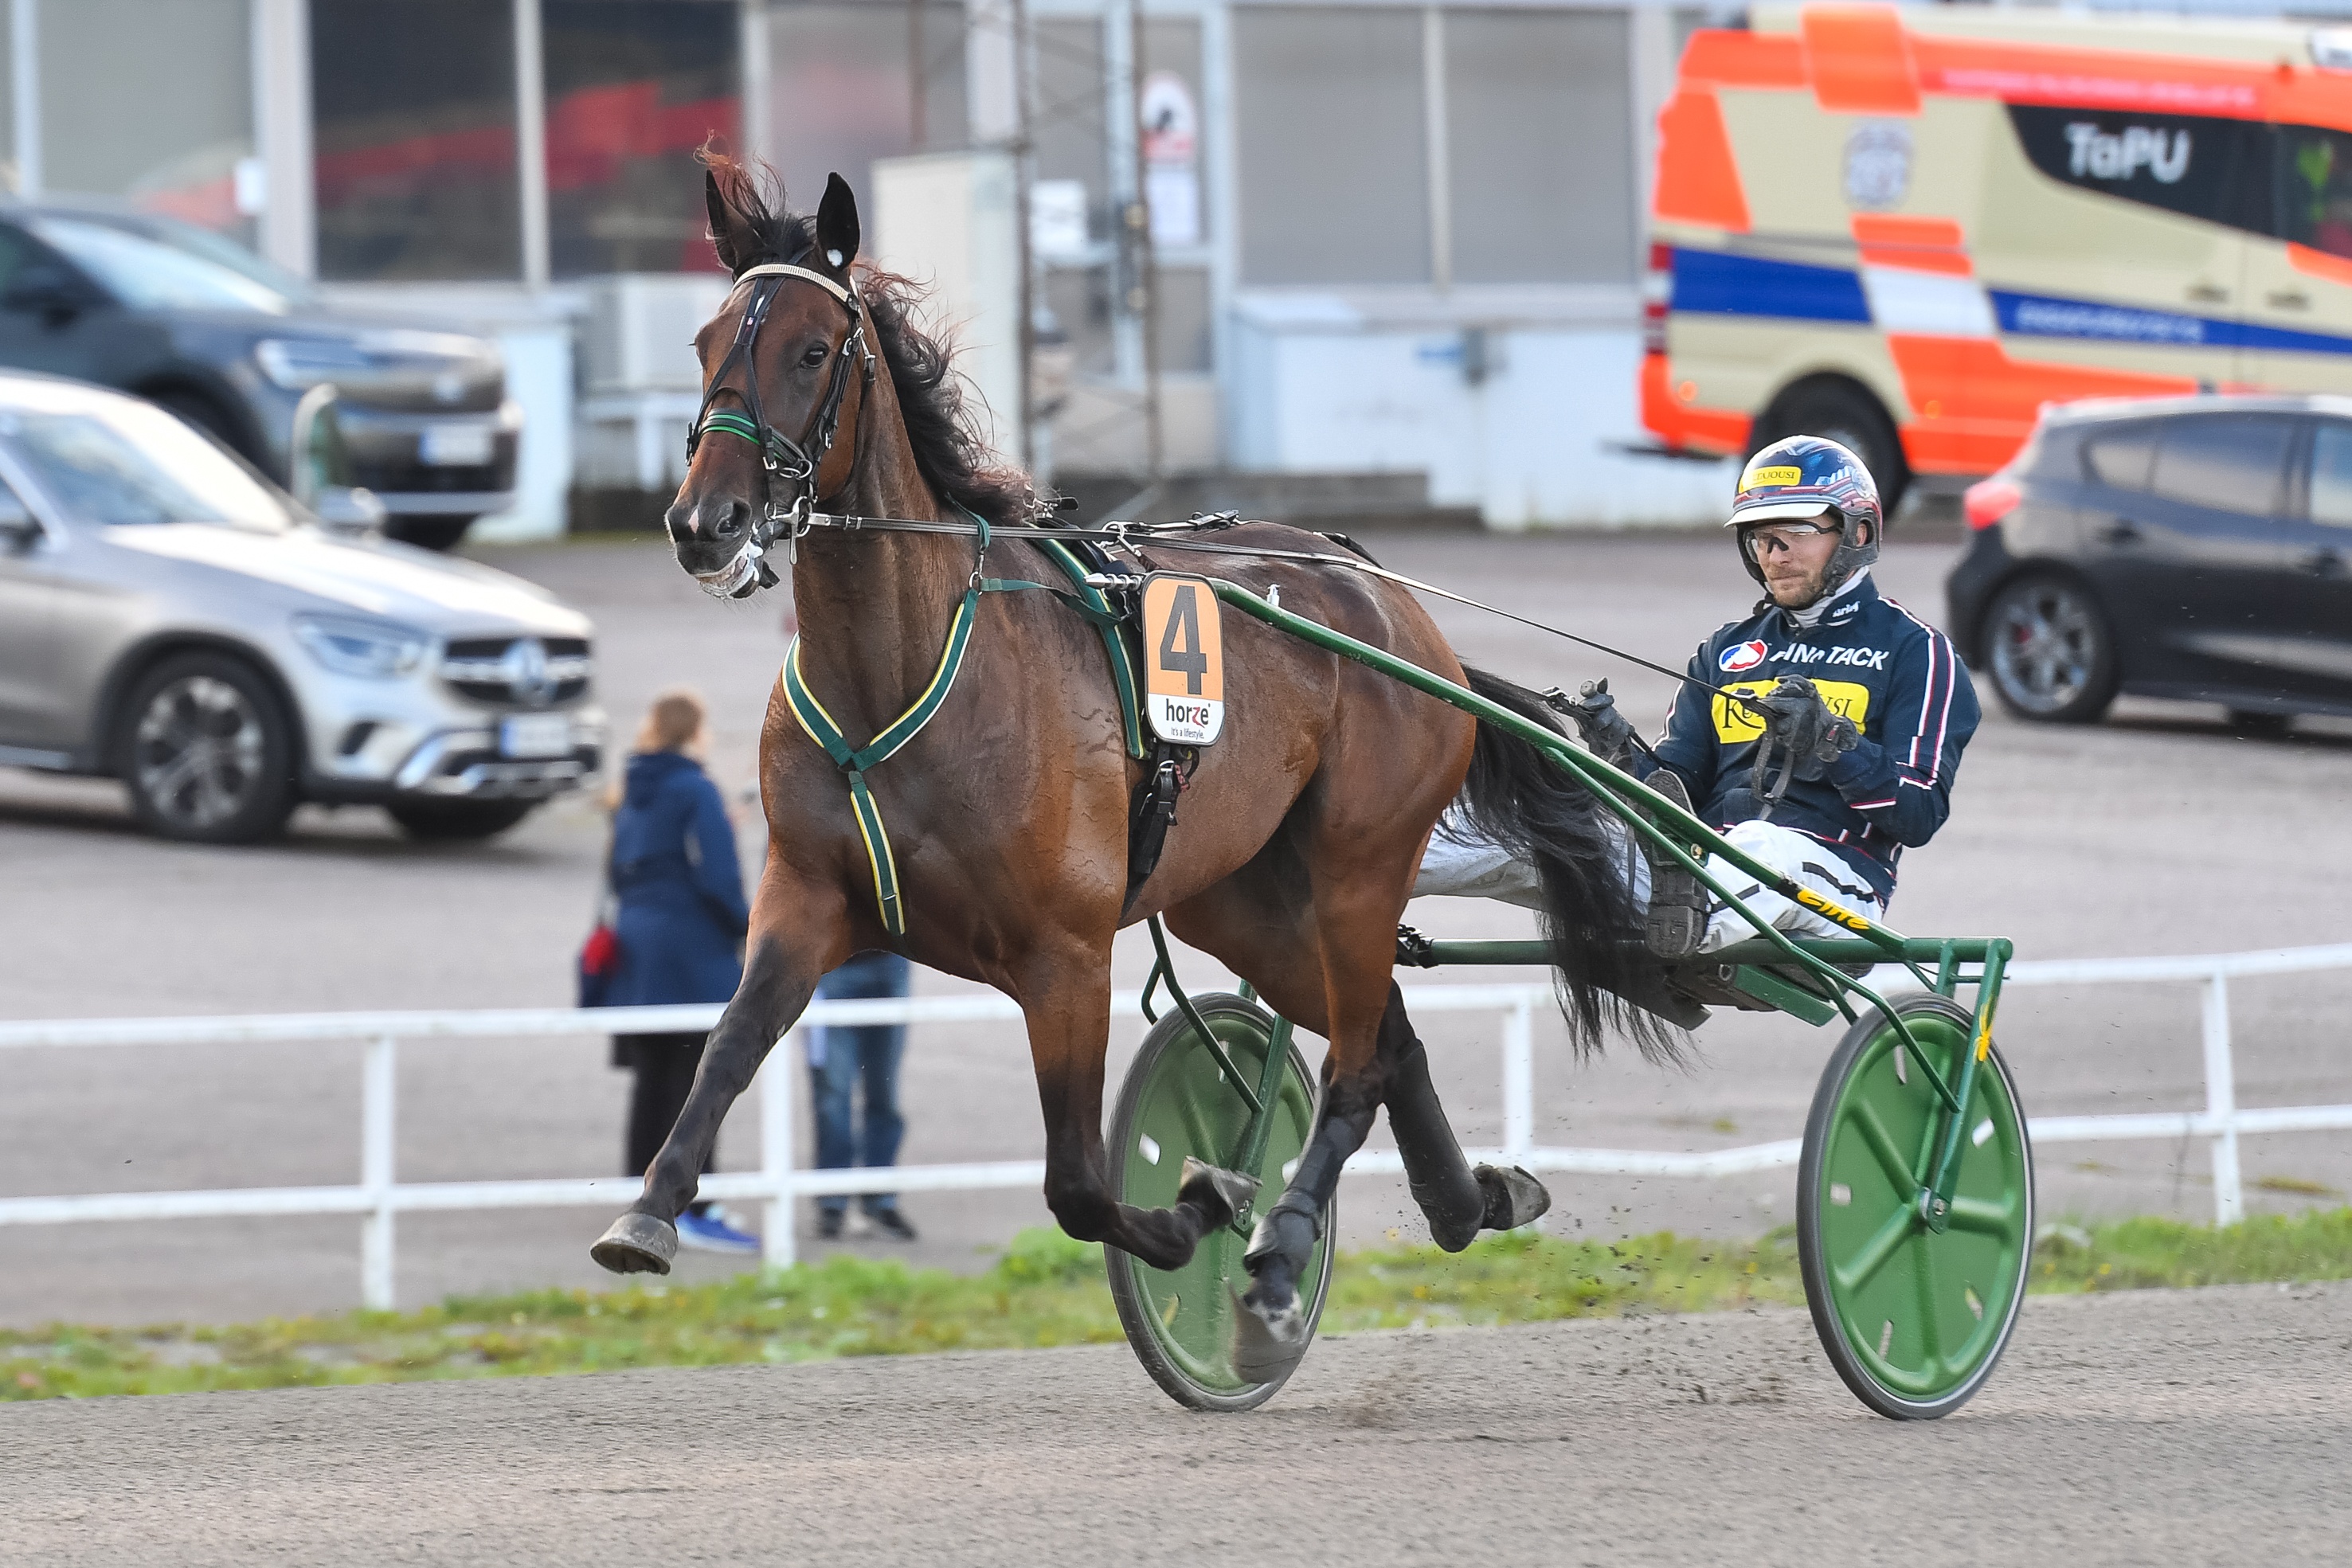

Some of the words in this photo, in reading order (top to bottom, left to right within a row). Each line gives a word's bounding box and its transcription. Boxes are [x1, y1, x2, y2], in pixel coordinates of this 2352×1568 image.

[2063, 122, 2192, 184] TaPU
[1160, 585, 1207, 695] 4
[1165, 698, 1209, 729] horze
